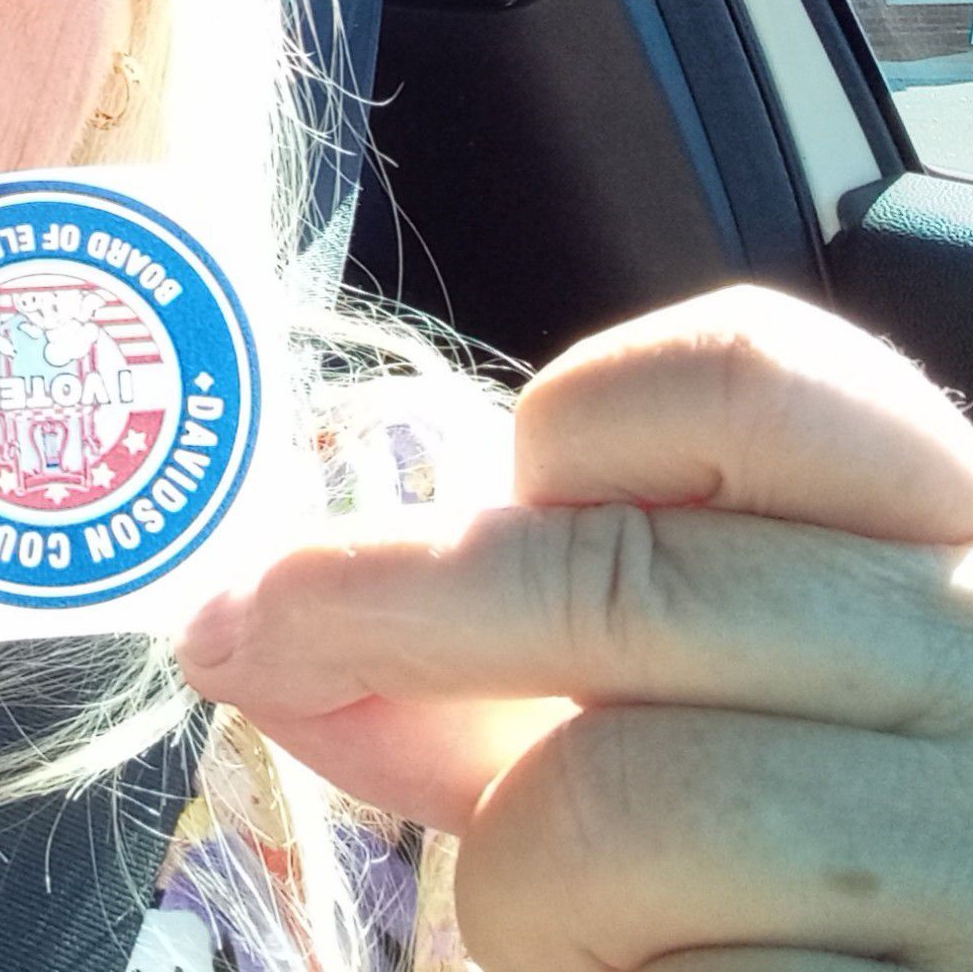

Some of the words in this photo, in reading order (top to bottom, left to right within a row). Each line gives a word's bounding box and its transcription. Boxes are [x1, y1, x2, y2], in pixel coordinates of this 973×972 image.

[42, 224, 81, 250] OF
[88, 231, 183, 306] BOARD
[118, 370, 133, 404] I
[84, 395, 224, 562] DAVIDSON
